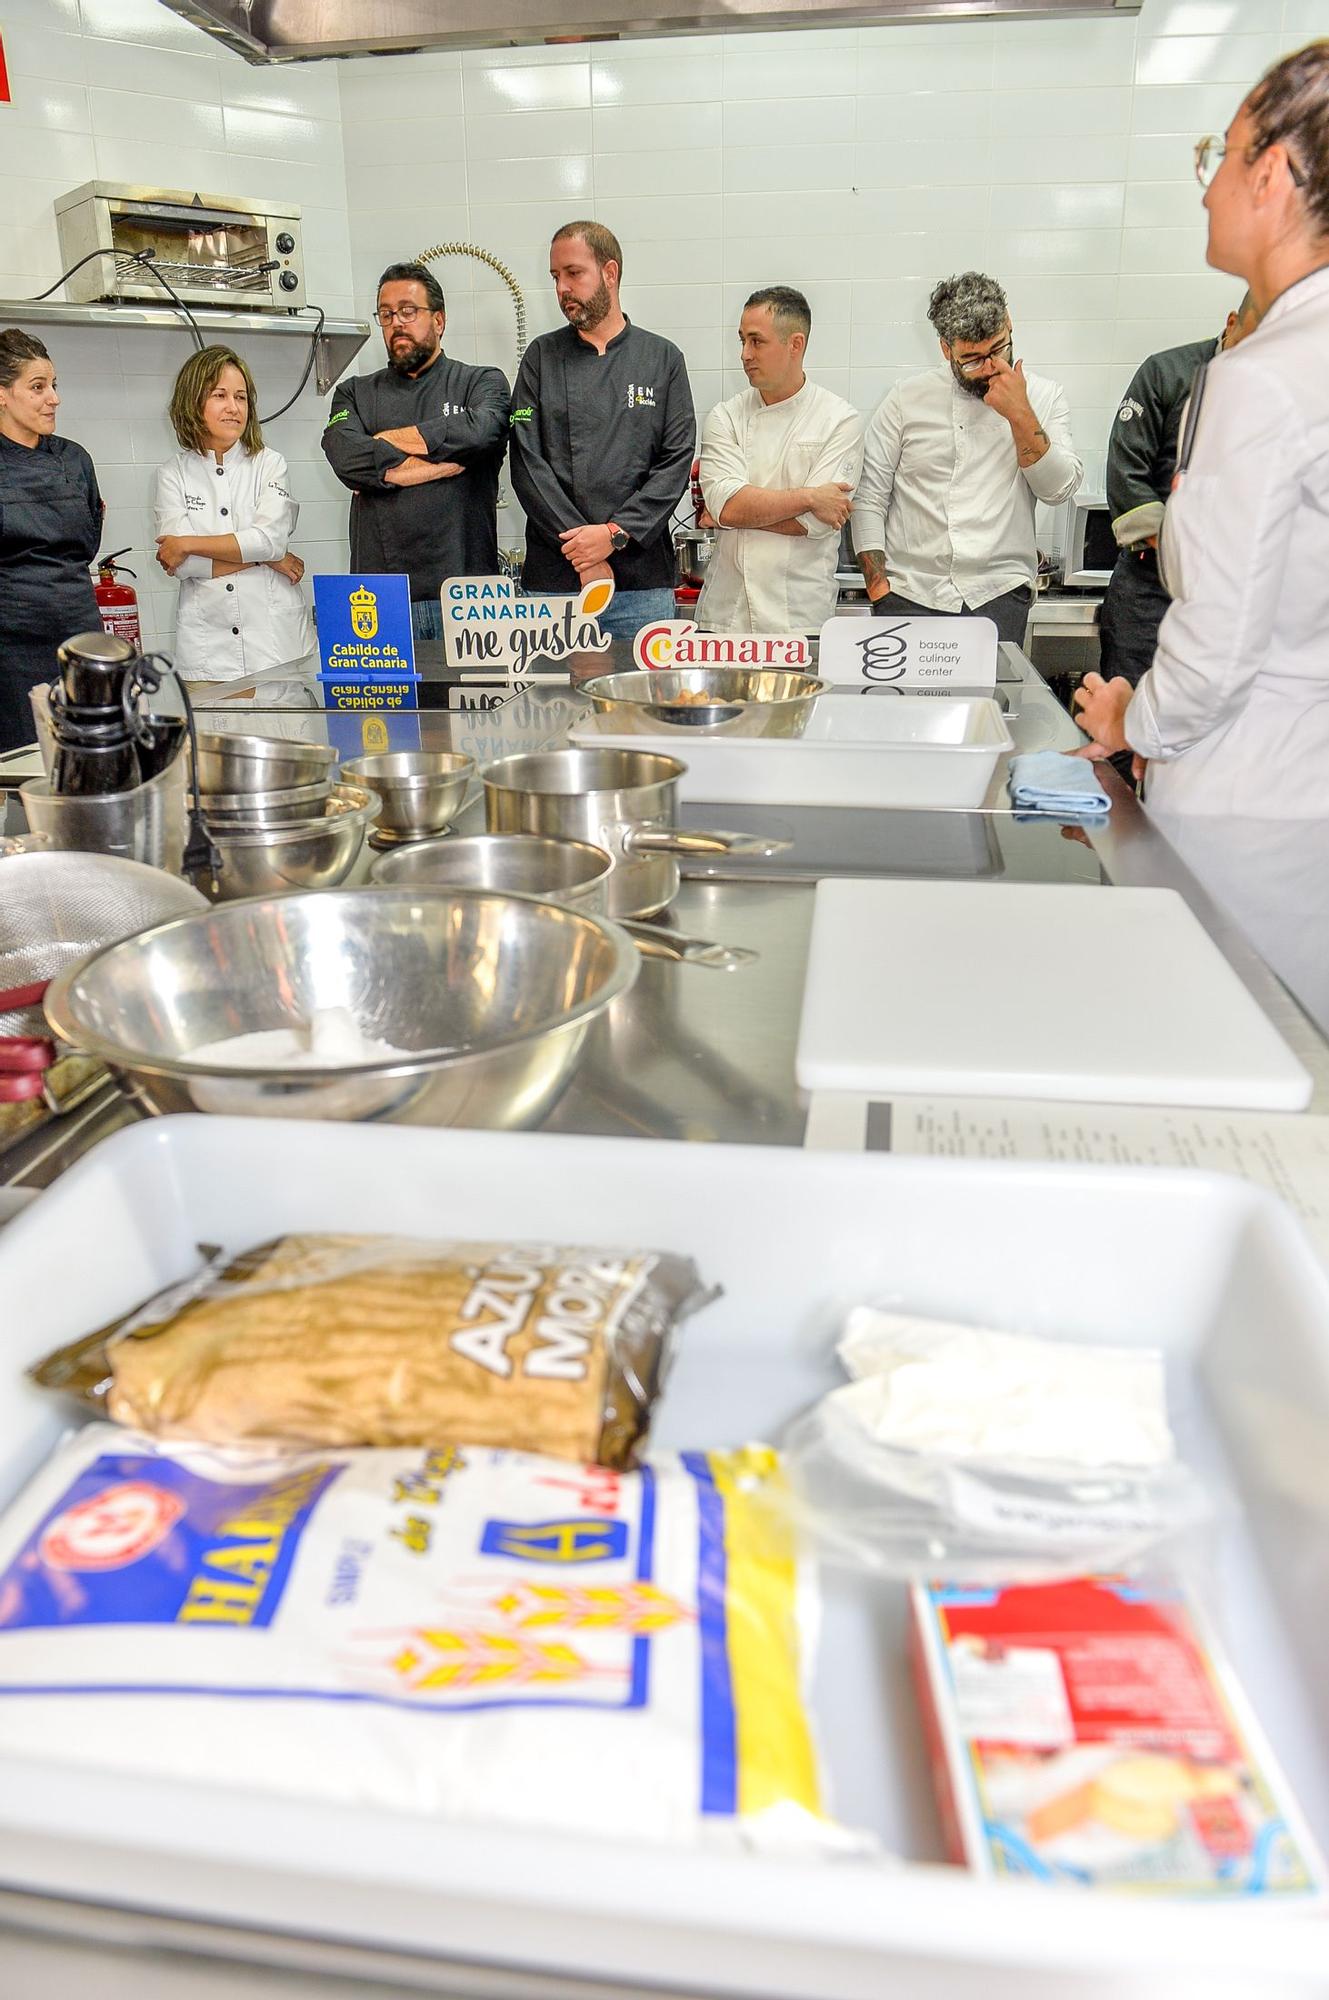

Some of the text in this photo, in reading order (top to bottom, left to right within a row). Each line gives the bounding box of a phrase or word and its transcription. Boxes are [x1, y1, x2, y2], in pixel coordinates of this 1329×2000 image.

[637, 386, 654, 398] EN
[449, 583, 511, 600] GRAN
[451, 603, 552, 621] CANARIA
[455, 600, 609, 674] me gusta
[332, 643, 399, 656] Cabildo de
[919, 639, 959, 650] basque
[328, 656, 408, 669] Gran Canaria
[919, 653, 961, 665] culinary
[918, 667, 953, 677] center
